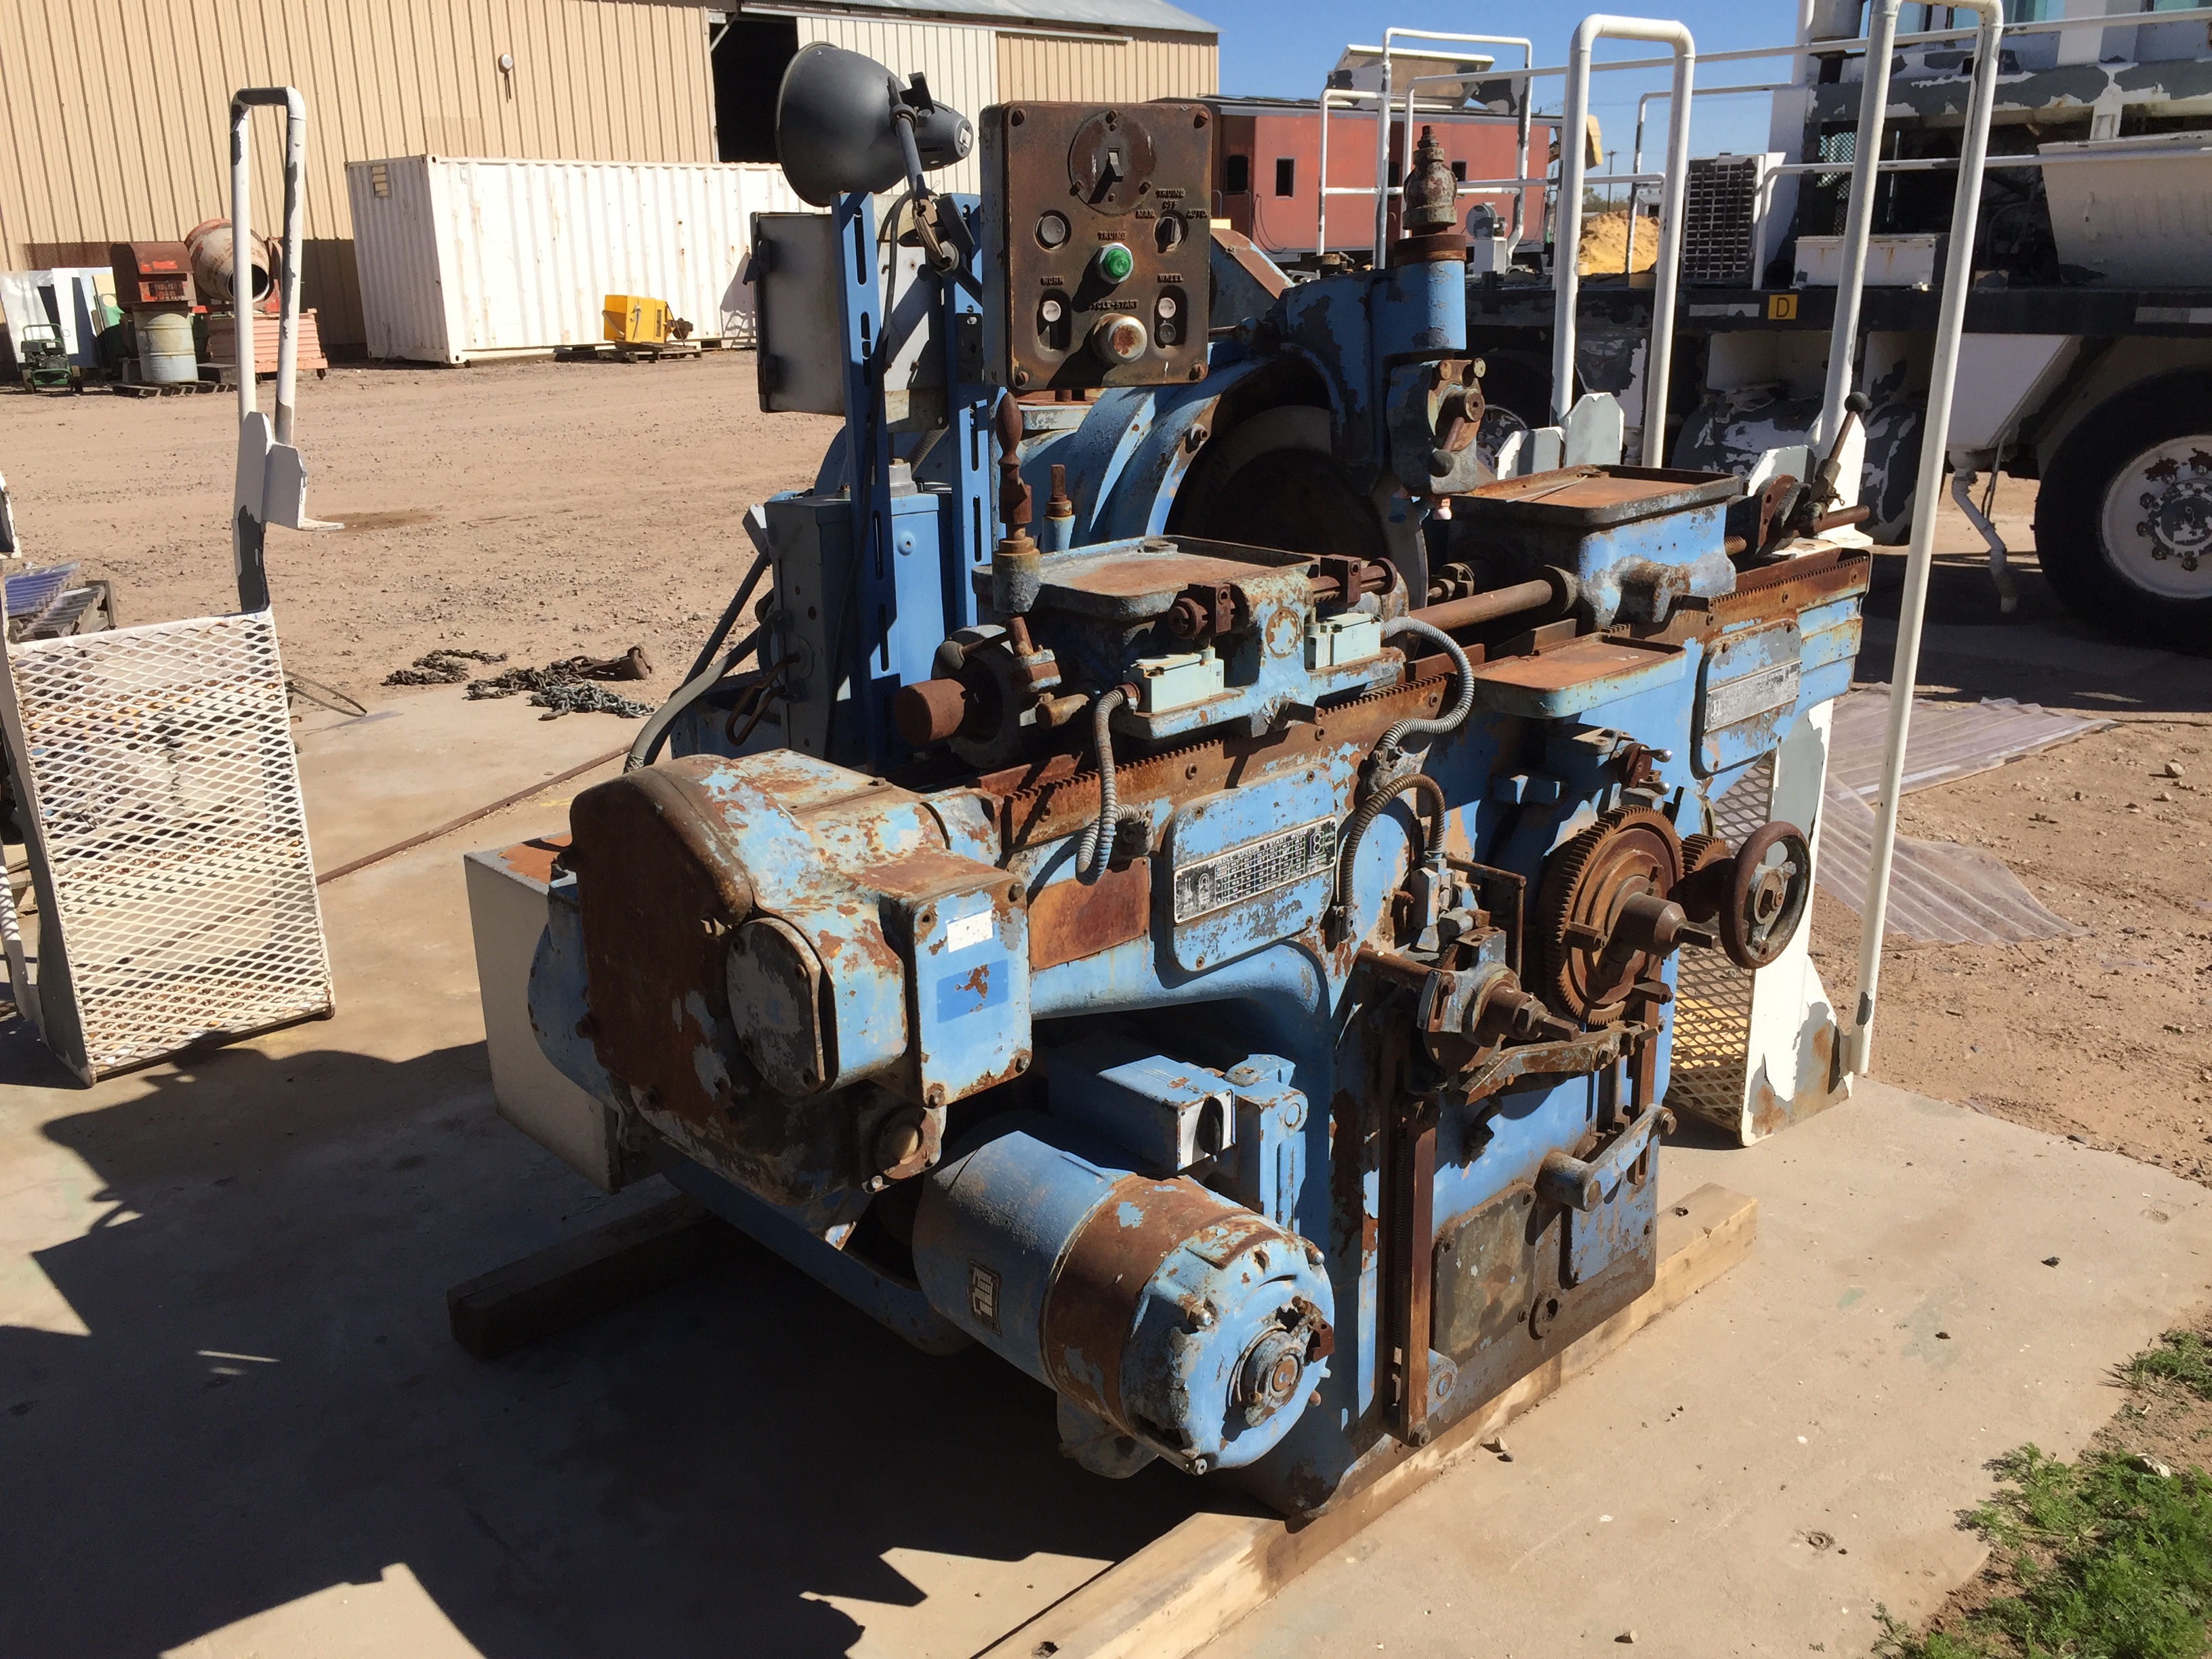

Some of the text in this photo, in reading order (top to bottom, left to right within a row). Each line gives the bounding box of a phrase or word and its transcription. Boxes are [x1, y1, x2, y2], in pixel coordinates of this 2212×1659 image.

[1040, 276, 1064, 286] WORK
[1157, 273, 1183, 284] WHEEL
[1776, 298, 1790, 317] D
[1208, 856, 1234, 869] SPINDLE
[1237, 847, 1260, 859] SPEEDS
[1269, 837, 1287, 847] START
